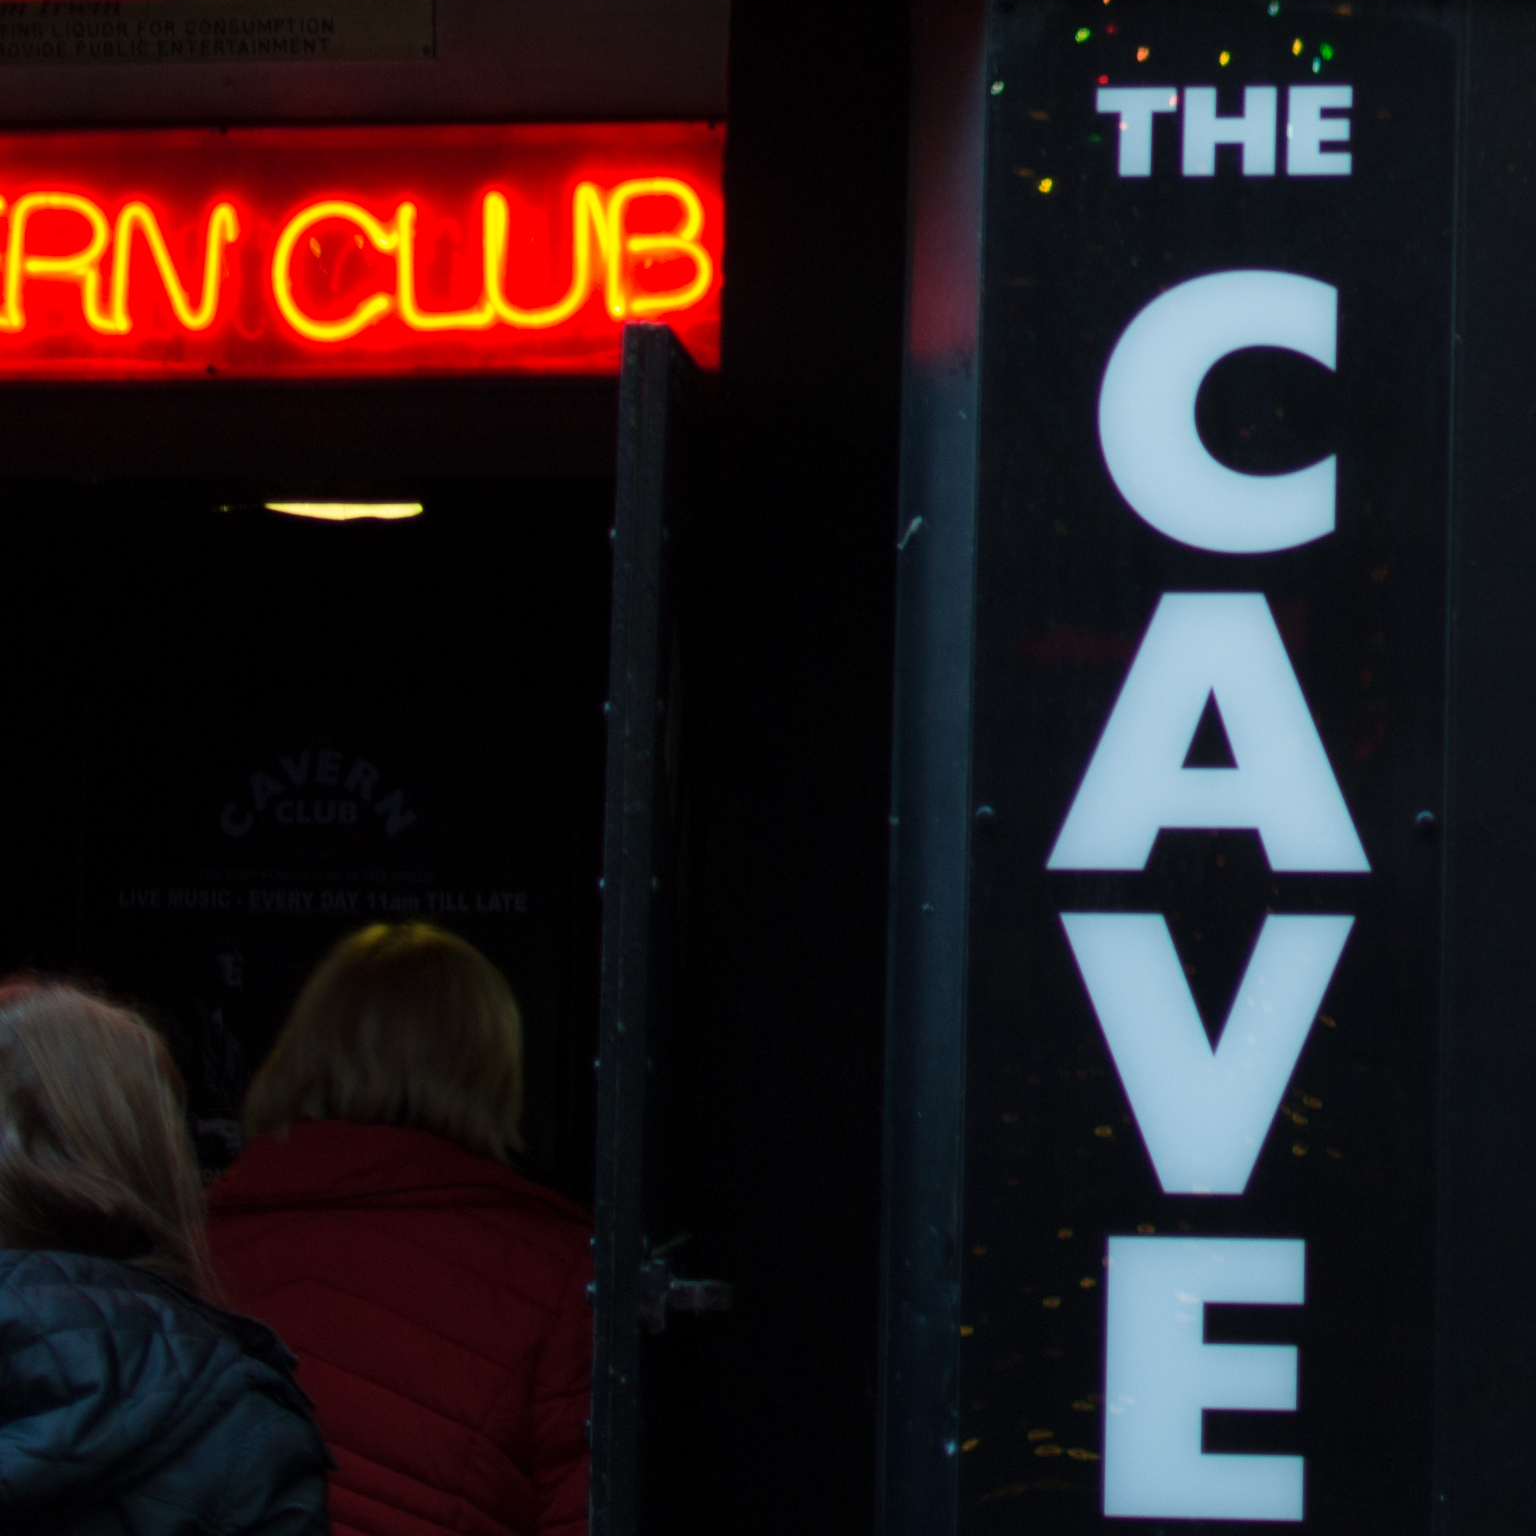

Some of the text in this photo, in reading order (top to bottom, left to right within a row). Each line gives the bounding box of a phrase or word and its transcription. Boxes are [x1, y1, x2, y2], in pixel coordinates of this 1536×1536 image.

[52, 18, 334, 38] LIQUOR FOR CONSUMPTION
[76, 38, 329, 57] PUBLIC ENTERTAINMENT
[1096, 85, 1353, 175] THE
[0, 175, 714, 342] RN CLUB
